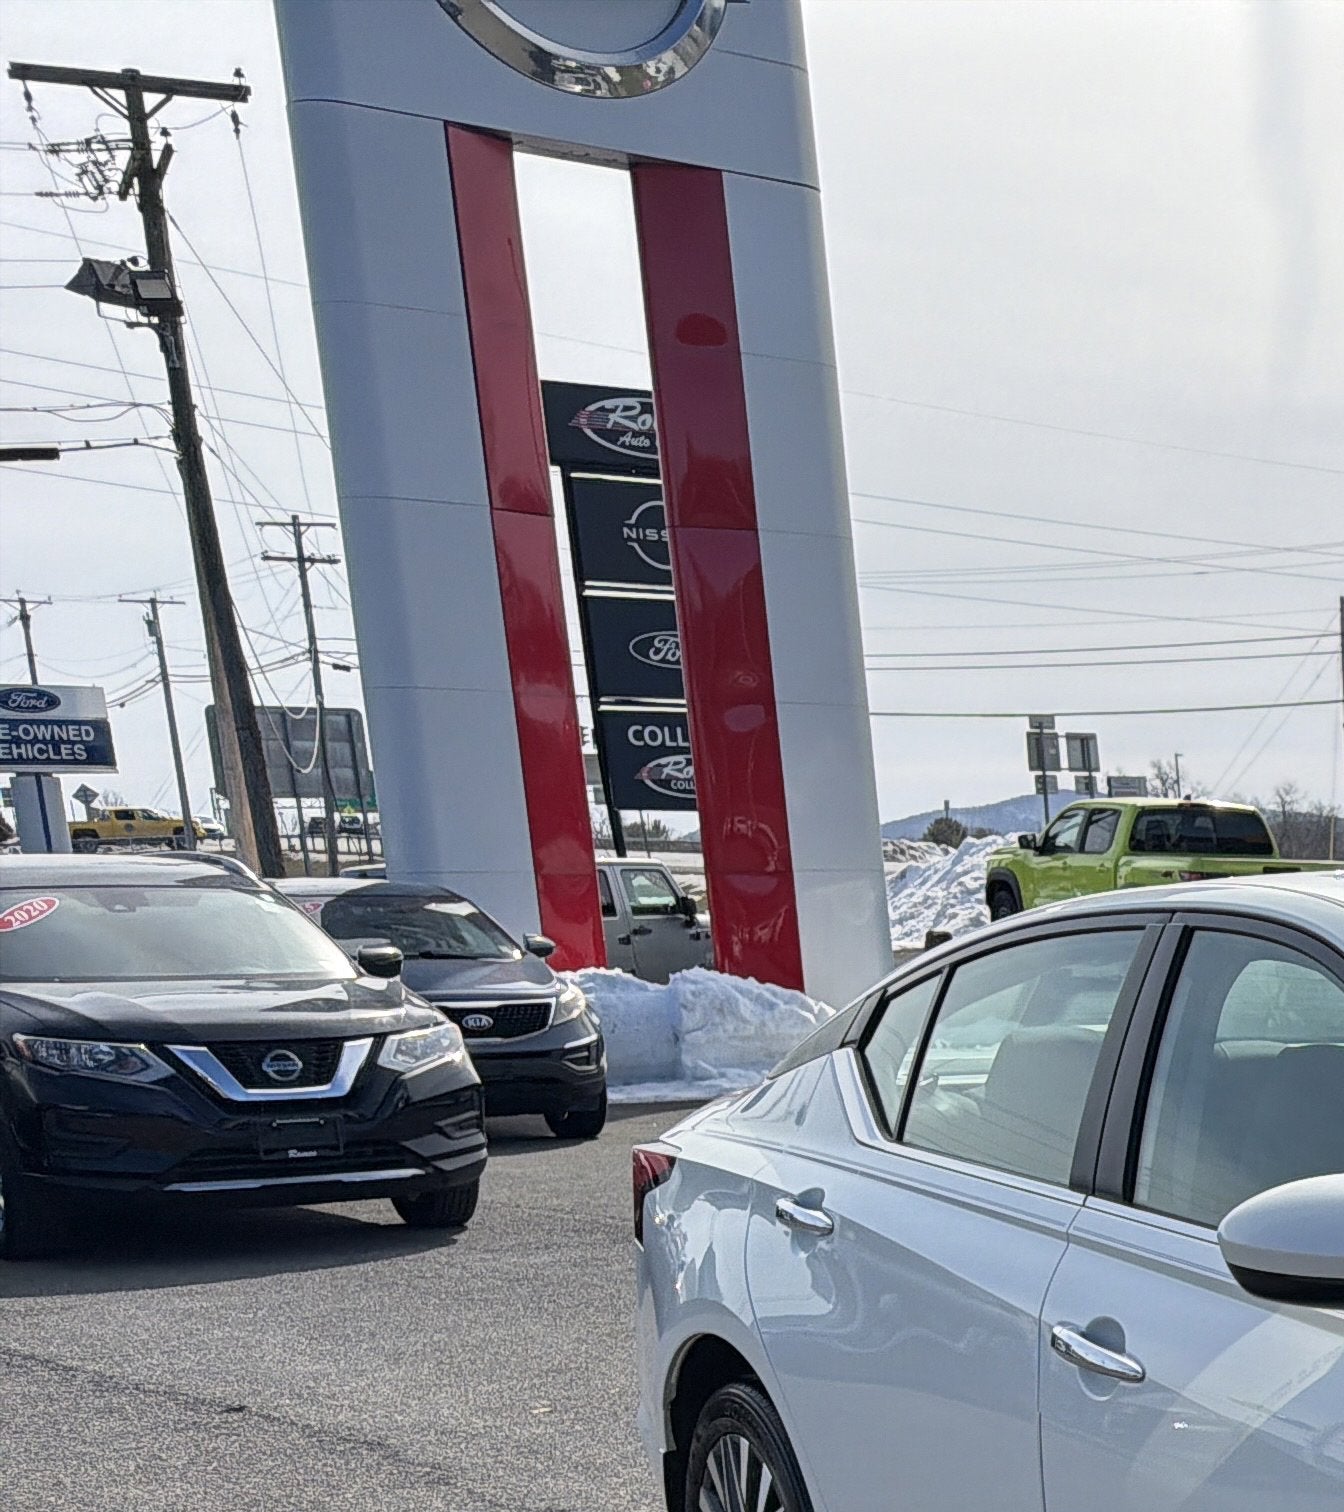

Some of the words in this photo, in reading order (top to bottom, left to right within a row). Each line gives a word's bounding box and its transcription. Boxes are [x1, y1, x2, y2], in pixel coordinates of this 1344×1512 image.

[604, 400, 656, 431] Ro
[617, 432, 651, 447] Auto
[622, 527, 669, 542] NISS
[649, 635, 681, 662] Fo
[8, 692, 48, 708] Ford
[0, 723, 95, 741] E-OWNED
[627, 725, 690, 747] COLL
[0, 743, 88, 760] EHICLES
[659, 757, 694, 779] Ro
[670, 780, 696, 790] COLL
[4, 900, 48, 927] 2020
[467, 1018, 489, 1027] KIA
